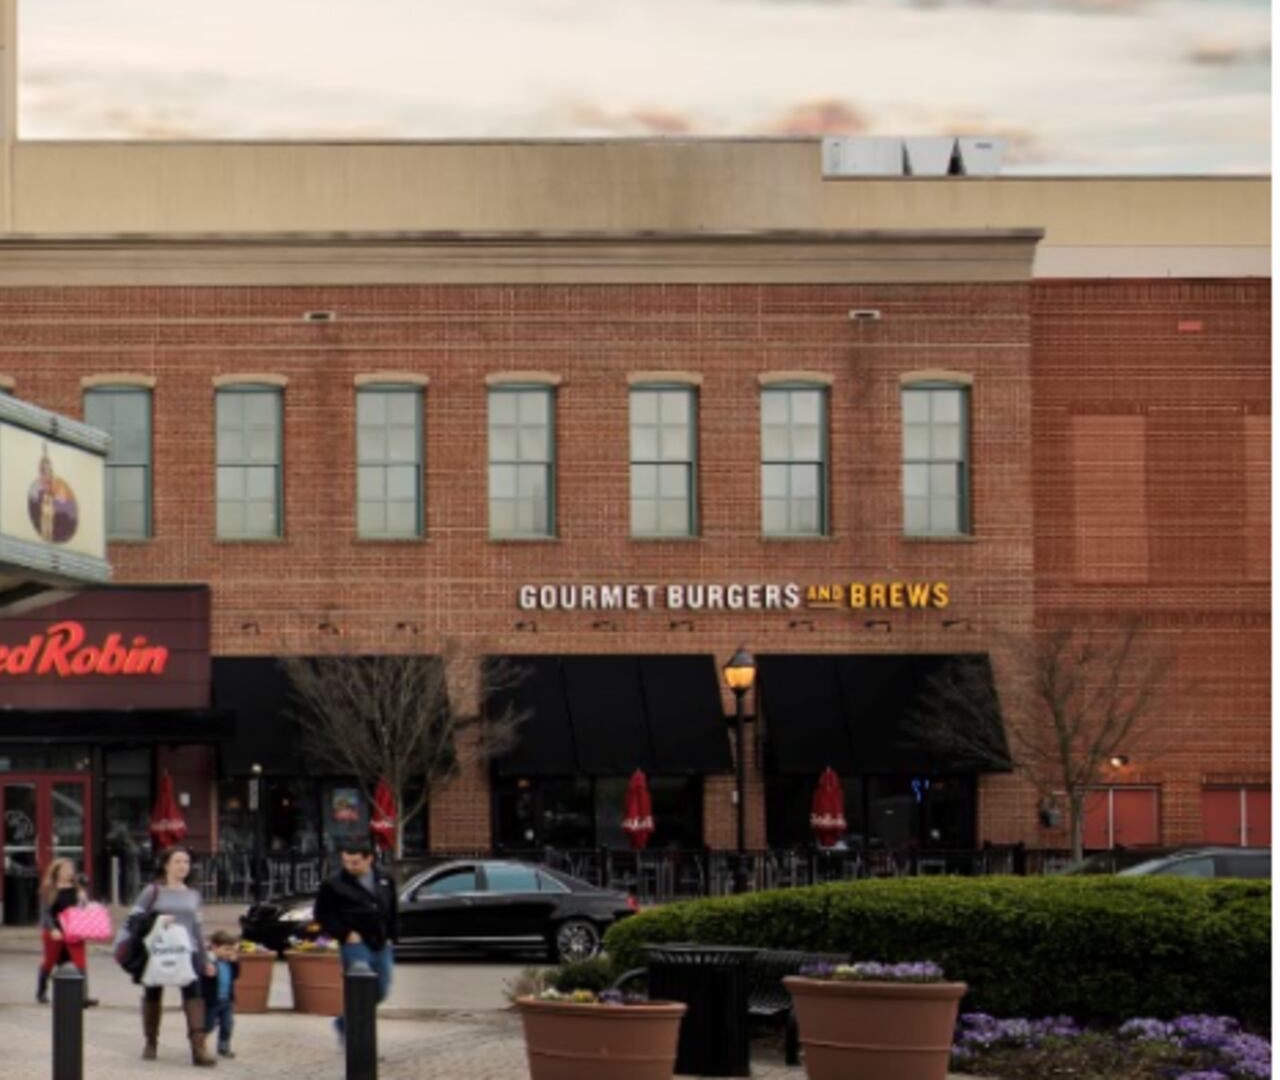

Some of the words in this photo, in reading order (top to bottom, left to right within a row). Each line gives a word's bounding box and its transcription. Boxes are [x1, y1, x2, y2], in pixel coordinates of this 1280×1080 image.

[518, 583, 658, 610] GOURMET
[666, 582, 801, 610] BURGERS
[806, 585, 843, 602] AND
[849, 582, 950, 609] BREWS
[36, 620, 169, 677] Robin
